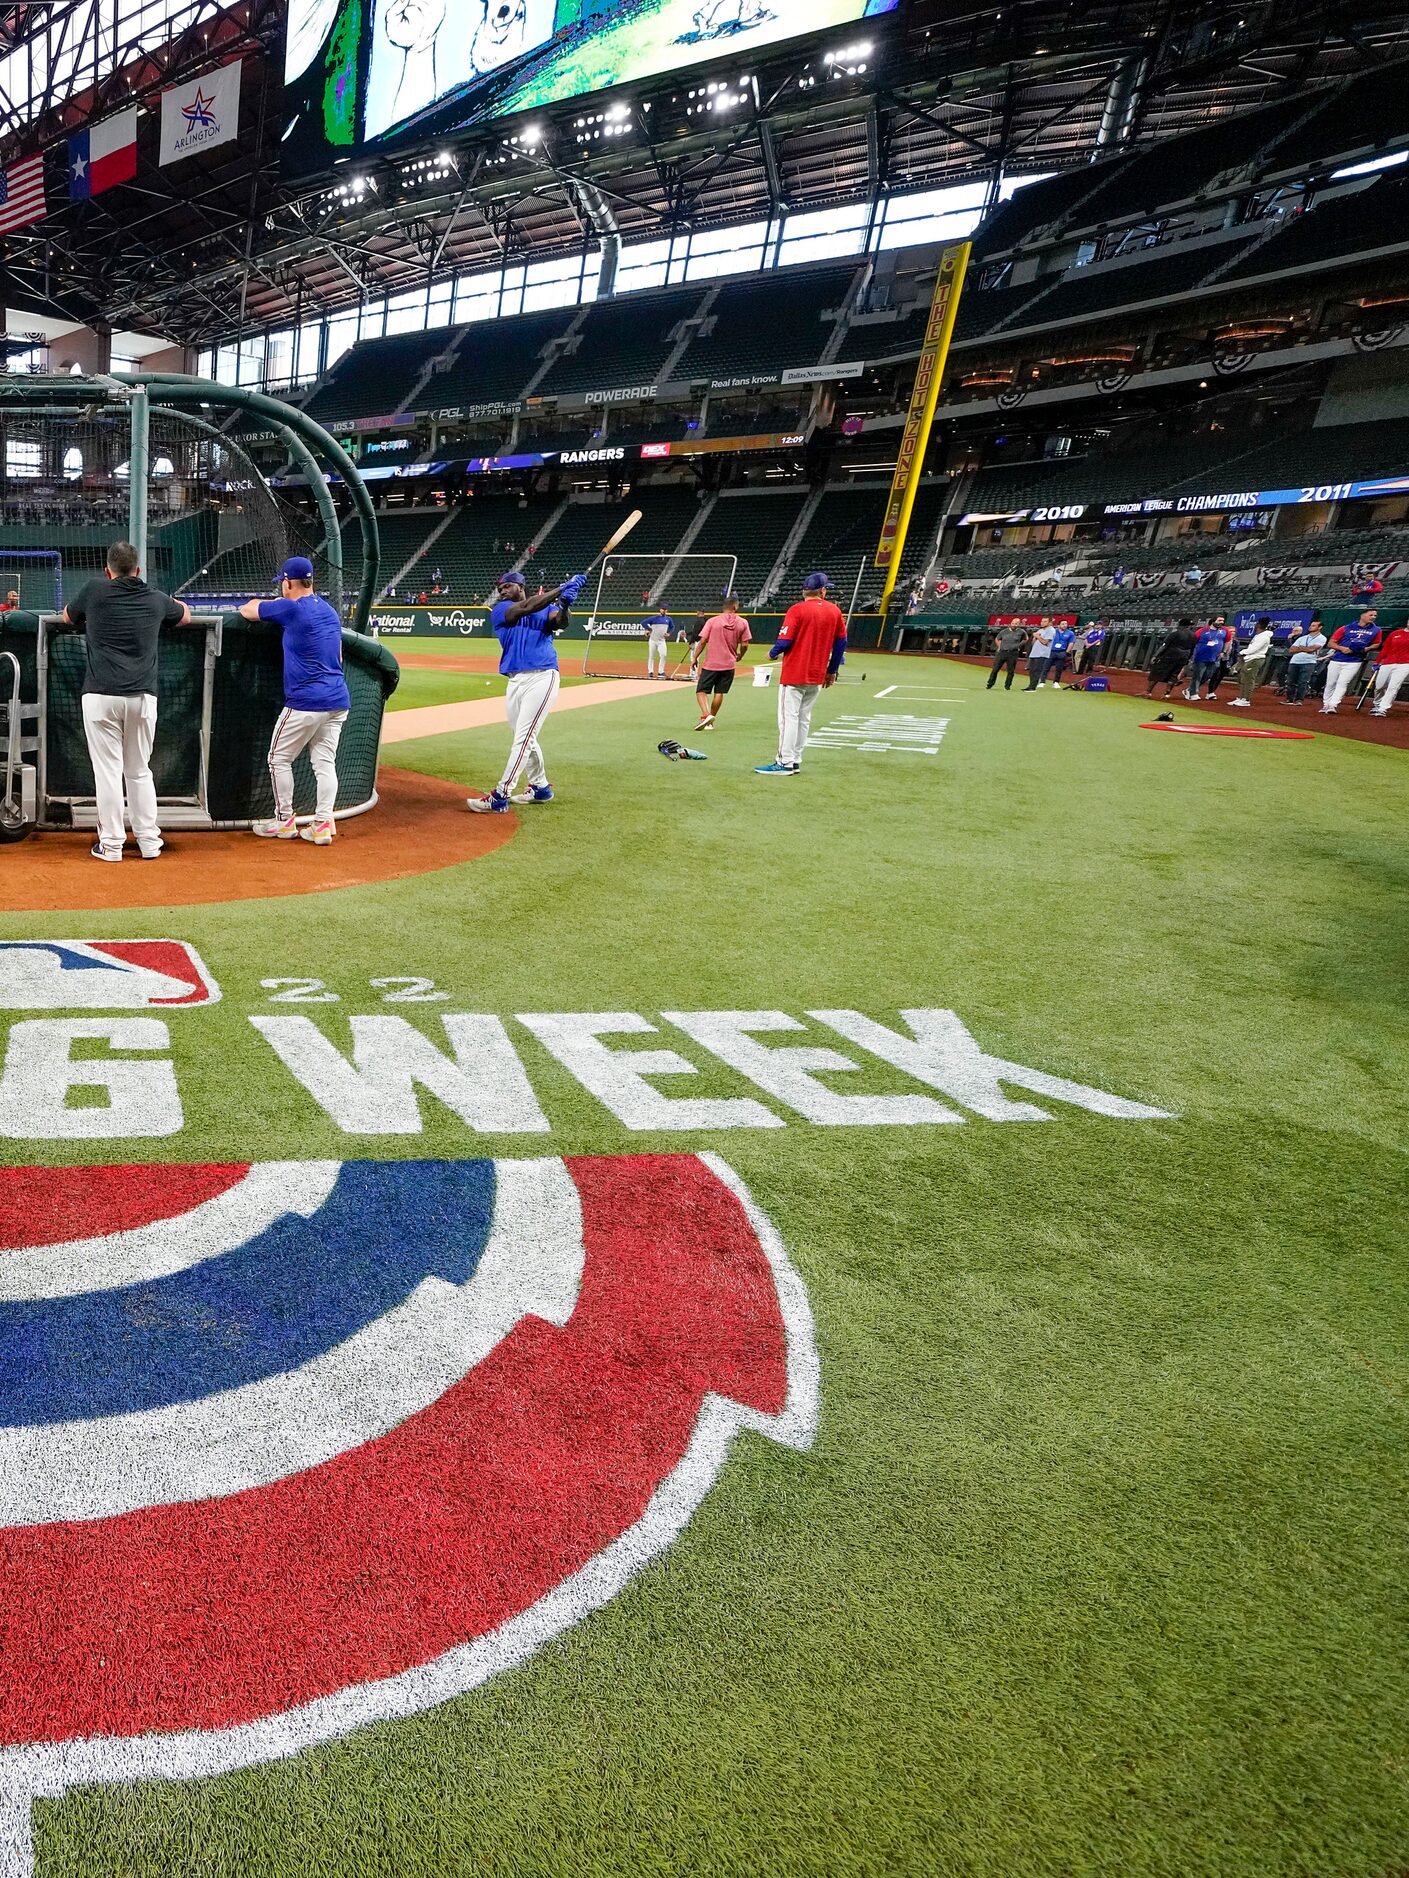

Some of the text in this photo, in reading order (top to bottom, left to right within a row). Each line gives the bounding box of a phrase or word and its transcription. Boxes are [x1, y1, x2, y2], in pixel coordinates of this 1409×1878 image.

[174, 125, 221, 151] ARLINGTON
[711, 375, 778, 389] Real fans know.
[895, 286, 950, 488] THE HOT ZONE
[584, 386, 658, 404] POWERADE
[439, 407, 464, 419] PGL
[469, 401, 522, 412] ShipPGL.com
[469, 407, 521, 418] 877.701.1919
[332, 422, 355, 432] 105.3
[781, 435, 804, 444] 12:09
[560, 448, 625, 463] RANGERS
[643, 443, 666, 453] DEX
[1296, 483, 1353, 503] 2011
[1104, 492, 1259, 515] AMERICAN LEAGUE CHAMPIONS
[1034, 505, 1085, 521] 2010
[445, 610, 486, 635] Kroger
[247, 1007, 1184, 1136] WEEK
